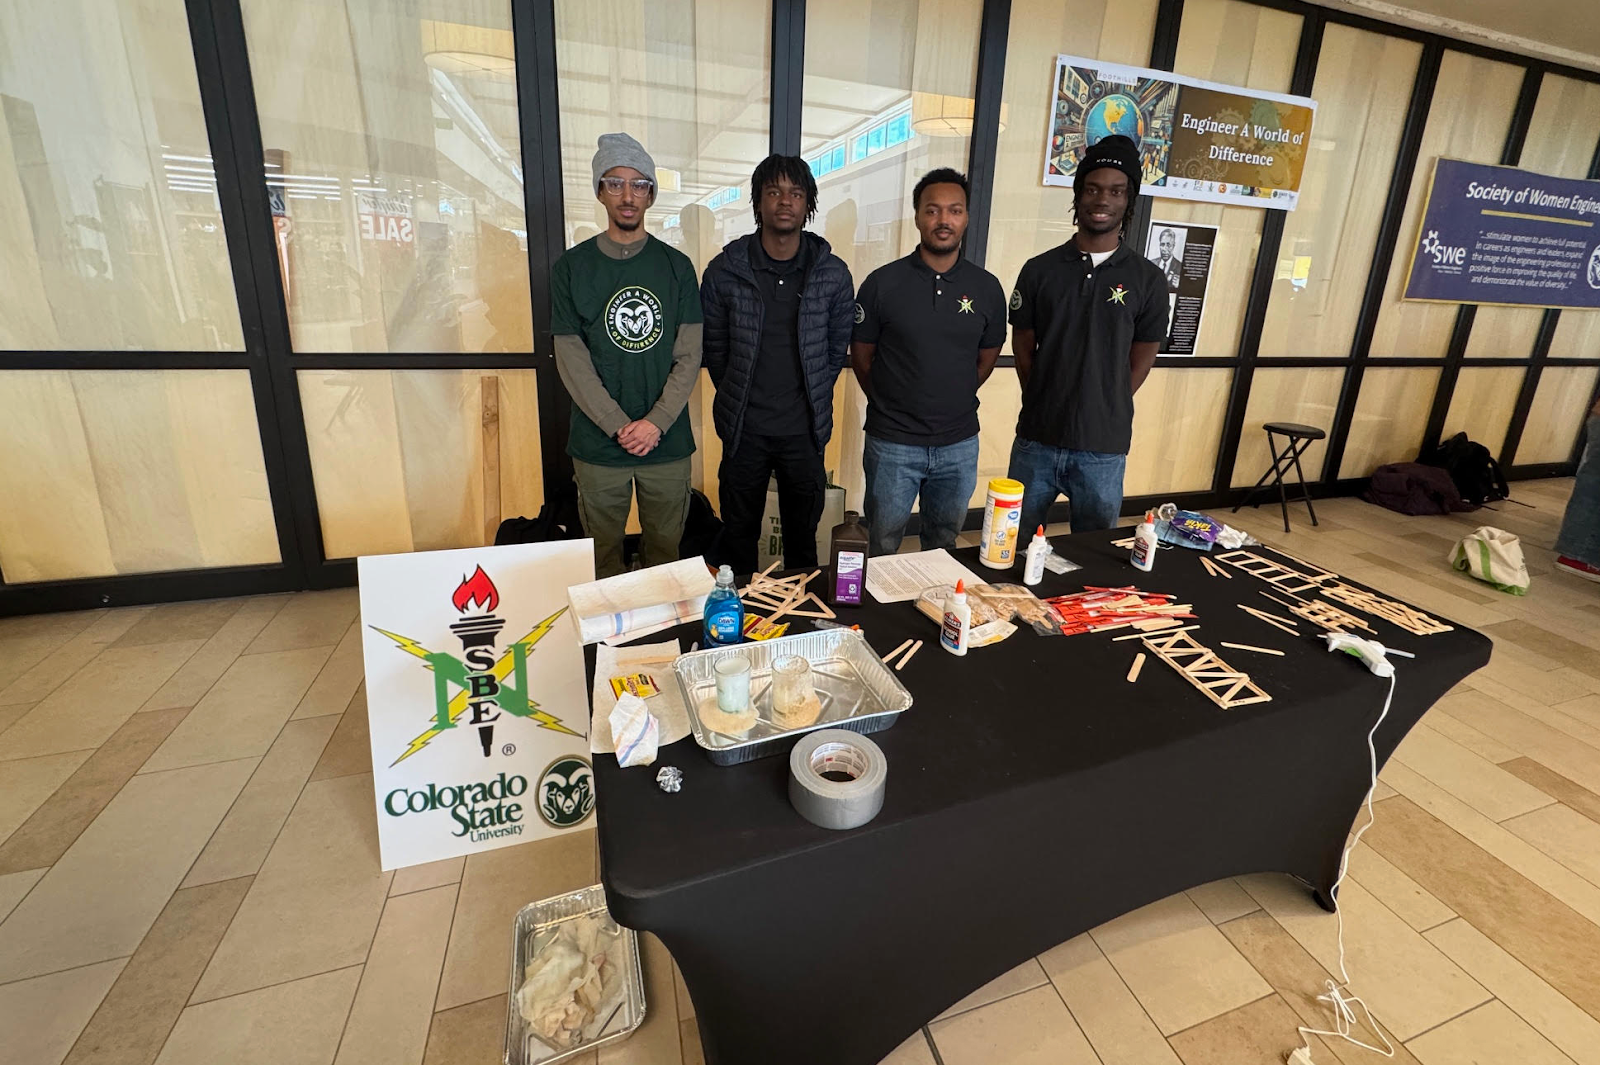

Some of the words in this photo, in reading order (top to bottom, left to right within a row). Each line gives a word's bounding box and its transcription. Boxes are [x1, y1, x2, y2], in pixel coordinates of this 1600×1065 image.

[1098, 73, 1137, 84] FOOTHILLS
[1181, 113, 1239, 135] Engineer
[1240, 123, 1249, 137] A
[1253, 125, 1290, 143] World
[1292, 132, 1305, 145] of
[1208, 145, 1274, 166] Difference
[1466, 181, 1515, 205] Society
[1514, 187, 1530, 203] of
[1529, 189, 1571, 209] Women
[1570, 195, 1600, 215] Engine
[642, 293, 661, 321] WORLD
[612, 331, 622, 341] OF
[384, 772, 528, 817] Colorado
[451, 800, 524, 837] State
[469, 824, 525, 843] University
